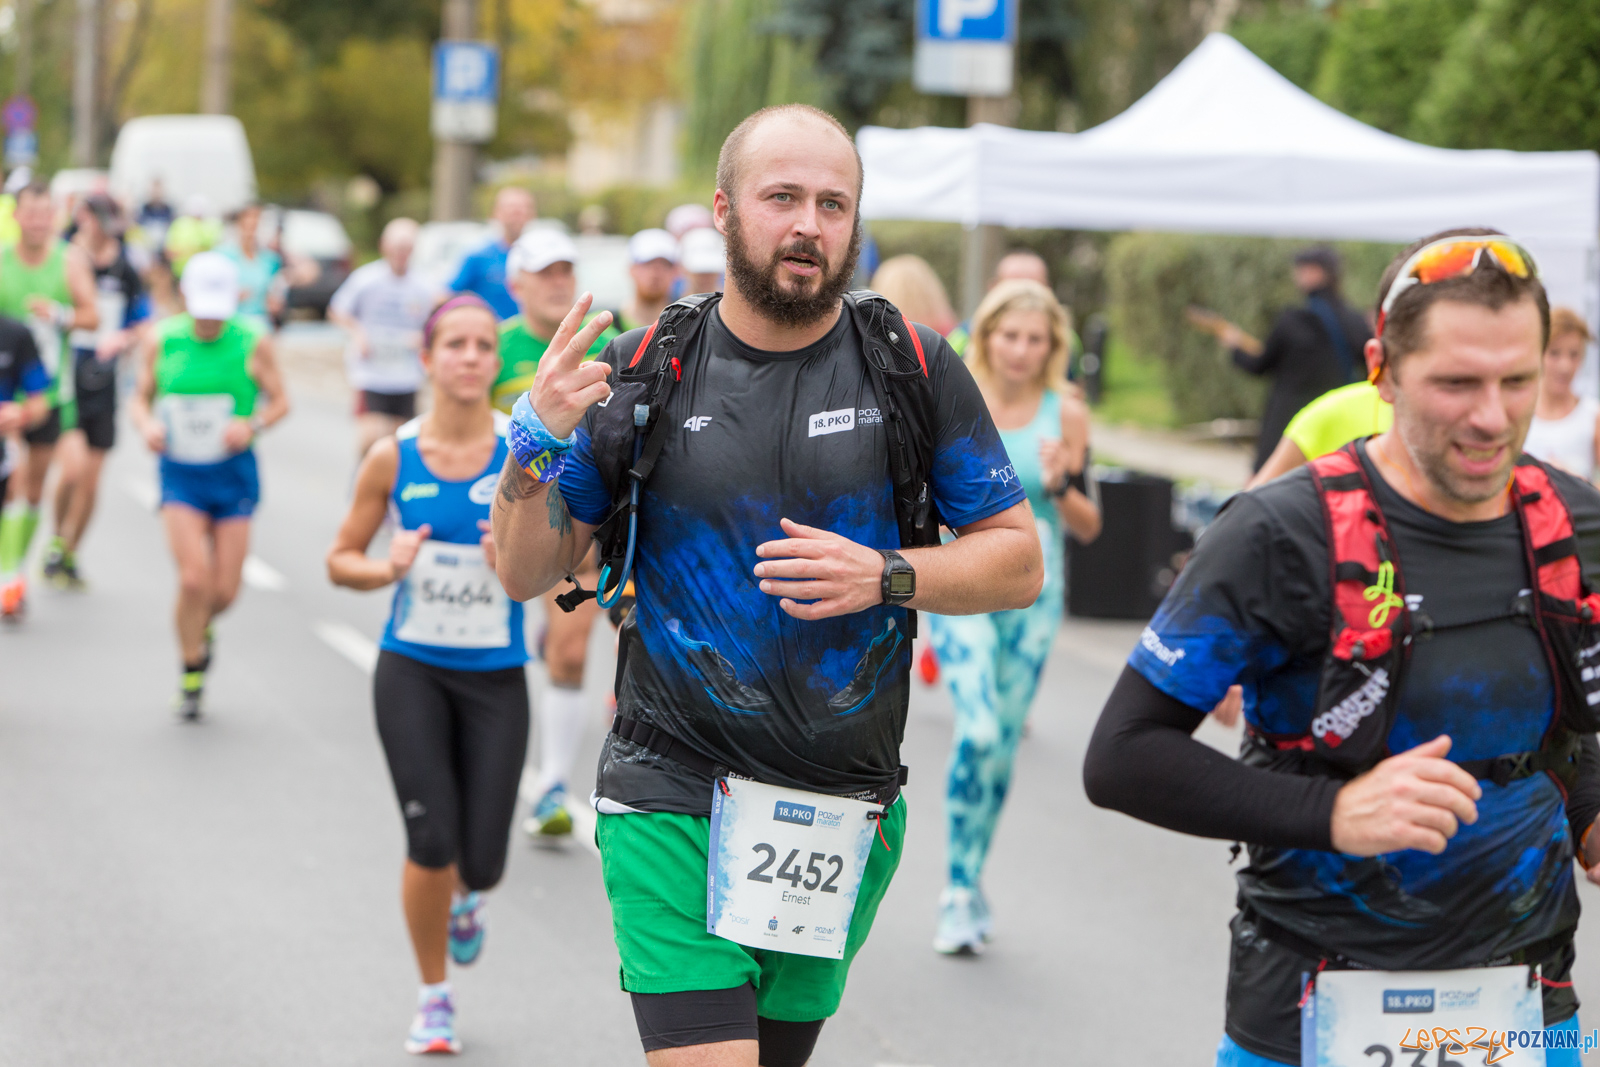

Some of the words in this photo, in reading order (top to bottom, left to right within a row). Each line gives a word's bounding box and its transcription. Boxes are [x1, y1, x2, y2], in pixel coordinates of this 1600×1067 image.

[445, 48, 488, 91] P
[813, 418, 826, 429] 18.
[828, 414, 850, 427] PKO
[779, 802, 791, 817] 18.
[792, 804, 812, 821] PKO
[817, 818, 841, 828] maraton
[747, 843, 844, 894] 2452
[782, 890, 811, 905] Ernest
[1404, 994, 1432, 1008] PKO
